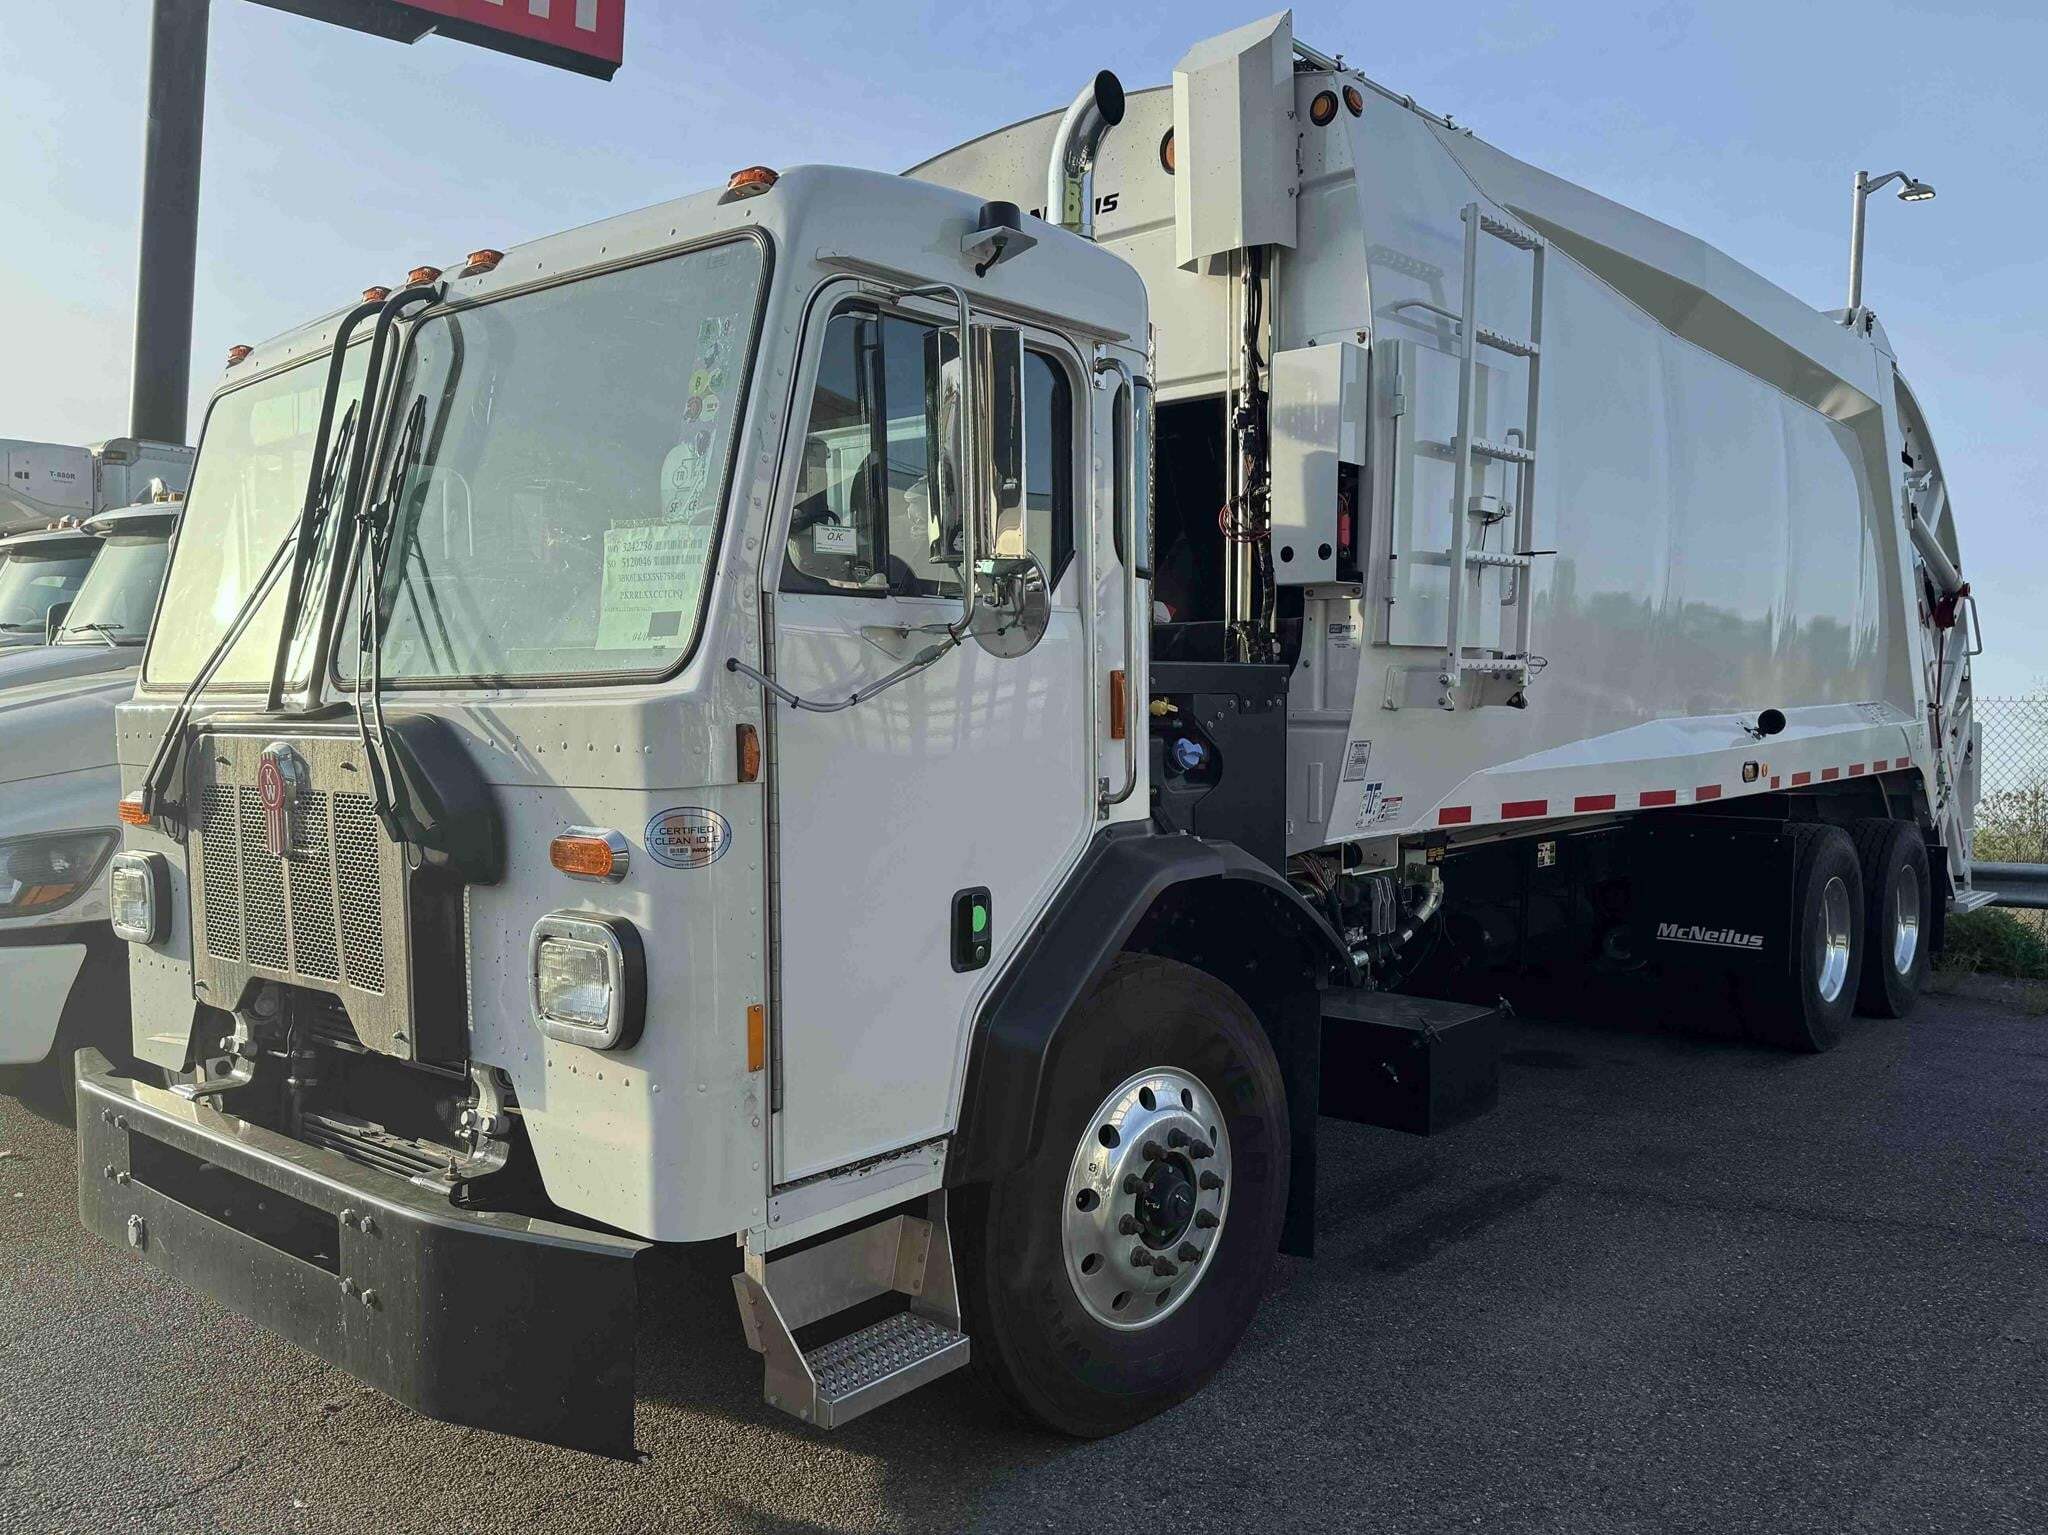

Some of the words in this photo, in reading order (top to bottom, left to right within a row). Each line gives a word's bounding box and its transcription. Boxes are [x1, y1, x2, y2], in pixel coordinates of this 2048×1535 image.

[659, 826, 715, 835] CERTIFIED
[655, 836, 691, 846] CLEAN
[696, 835, 720, 844] IDLE
[1656, 922, 1764, 946] McNeilus
